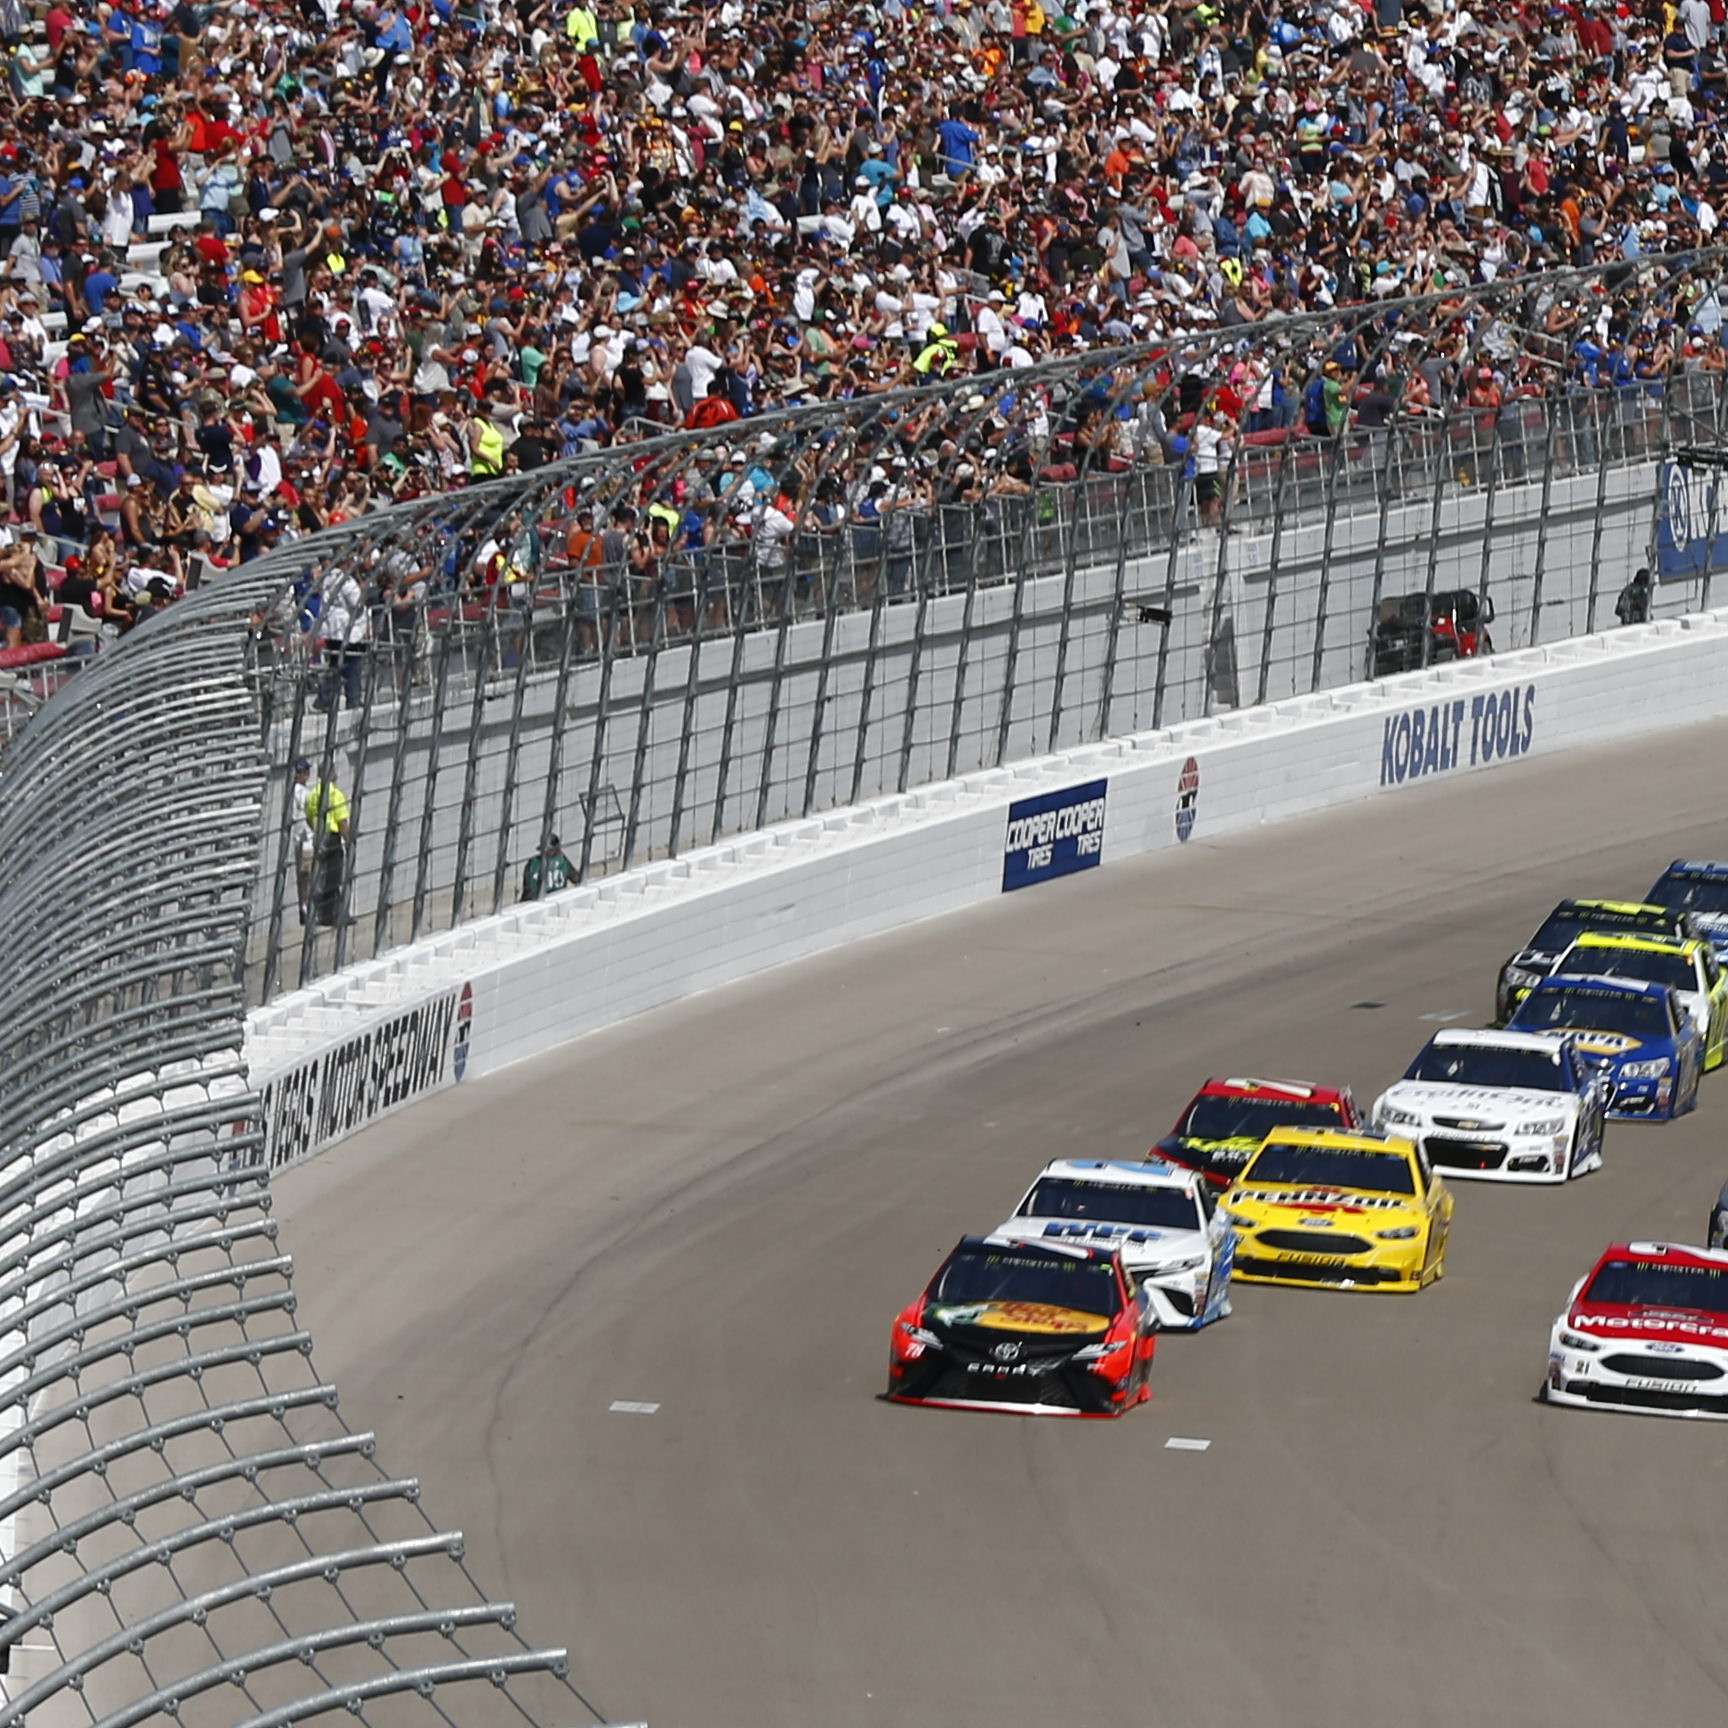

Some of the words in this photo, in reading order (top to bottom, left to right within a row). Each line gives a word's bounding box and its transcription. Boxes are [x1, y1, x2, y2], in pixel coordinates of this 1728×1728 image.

[1380, 696, 1467, 786] KOBALT
[1470, 683, 1537, 767] TOOLS
[1006, 812, 1057, 853] COOPER
[1056, 797, 1104, 838] COOPER
[270, 1058, 318, 1170] VEGAS
[314, 1032, 372, 1147] MOTOR
[366, 992, 457, 1120] SPEEDWAY
[1276, 1253, 1346, 1268] FUSION
[1625, 1377, 1700, 1393] FUSION
